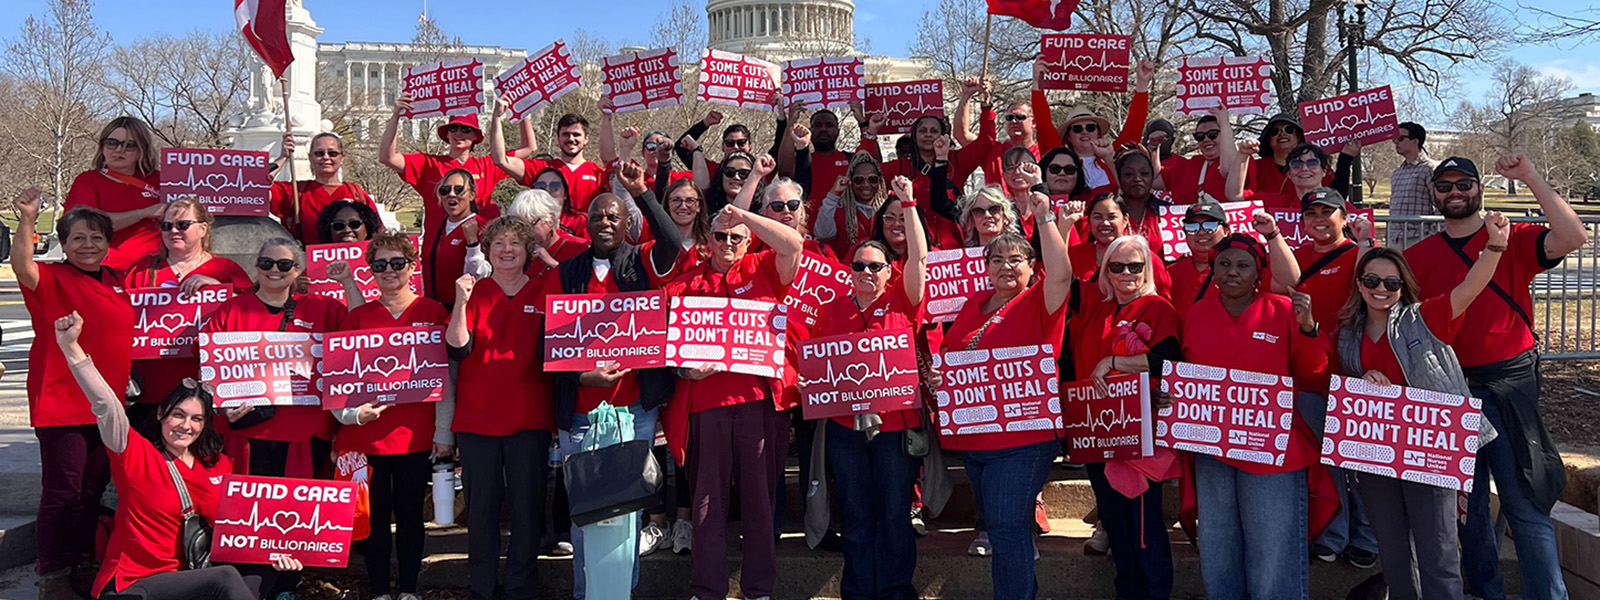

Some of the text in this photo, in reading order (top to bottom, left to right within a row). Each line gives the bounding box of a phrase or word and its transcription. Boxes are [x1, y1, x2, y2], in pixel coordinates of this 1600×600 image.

[1046, 38, 1126, 50] FUND CARE
[409, 68, 468, 88] SOME CUTS
[502, 68, 530, 90] SOME
[530, 52, 556, 74] CUTS
[608, 58, 664, 80] SOME CUTS
[710, 60, 768, 78] SOME CUTS
[791, 65, 850, 81] SOME CUTS
[1044, 72, 1124, 84] NOT BILLIONAIRES
[1186, 66, 1253, 82] SOME CUTS
[411, 80, 474, 100] DON'T HEAL
[510, 78, 538, 100] DON'T
[538, 62, 567, 83] HEAL
[614, 78, 642, 94] DON'T
[646, 71, 672, 86] HEAL
[712, 74, 773, 90] DON'T HEAL
[794, 76, 856, 92] DON'T HEAL
[867, 83, 938, 97] FUND CARE
[1190, 80, 1260, 95] DON'T HEAL
[1304, 90, 1388, 116] FUND CARE
[167, 152, 265, 168] FUND CARE
[199, 196, 265, 205] BILLIONAIRES
[312, 247, 362, 262] FUND
[800, 254, 832, 276] UND
[966, 260, 986, 274] CU
[929, 276, 994, 298] DON'T HE
[130, 292, 172, 306] UND
[552, 296, 660, 314] FUND CARE
[783, 295, 802, 308] OT
[681, 310, 766, 328] SOME CUTS
[329, 330, 442, 351] FUND CARE
[685, 327, 772, 346] DON'T HEAL
[214, 344, 304, 362] SOME CUTS
[552, 346, 660, 359] NOT BILLIONAIRES
[802, 334, 909, 358] FUND CARE
[220, 362, 314, 380] DON'T HEAL
[946, 364, 1034, 386] SOME CUTS
[330, 378, 442, 396] NOT BILLIONAIRES
[808, 385, 914, 405] NOT BILLIONAIRES
[954, 380, 1045, 405] DON'T HEAL
[1108, 380, 1138, 397] CARE
[1174, 382, 1269, 406] SOME CUTS
[1177, 402, 1276, 428] DON'T HEAL
[1342, 398, 1452, 427] SOME CUTS
[1072, 435, 1138, 449] NOT BILLIONAIRES
[1346, 419, 1459, 451] DON'T HEAL
[1427, 452, 1452, 461] National
[228, 482, 352, 503] FUND CARE
[220, 534, 343, 552] NOT BILLIONAIRES
